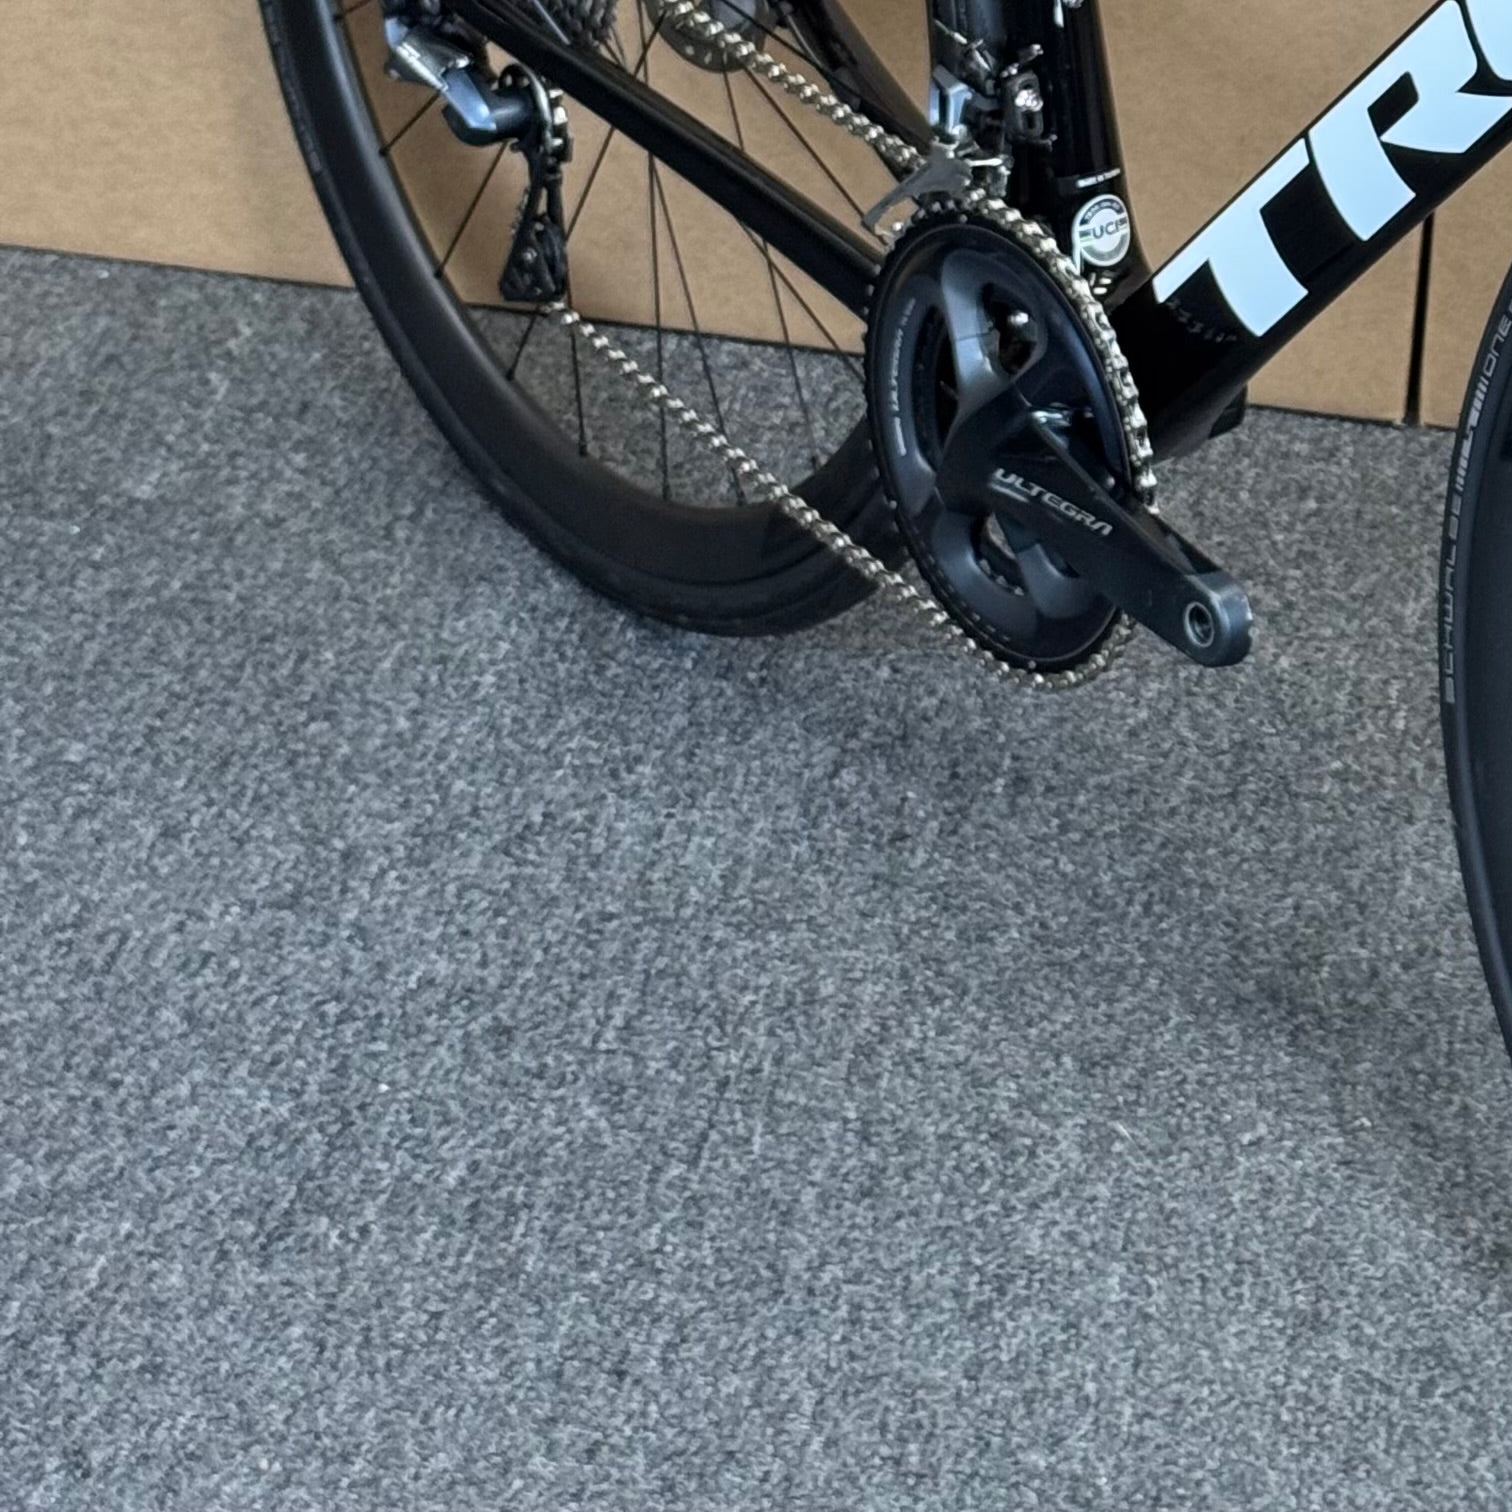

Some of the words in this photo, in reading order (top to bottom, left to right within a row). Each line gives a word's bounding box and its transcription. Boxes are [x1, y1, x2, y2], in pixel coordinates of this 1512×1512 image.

[1092, 220, 1121, 240] UCI
[993, 467, 1113, 536] ULTEGRA
[1444, 492, 1463, 704] SCHWALBE
[1483, 314, 1512, 378] ONE
